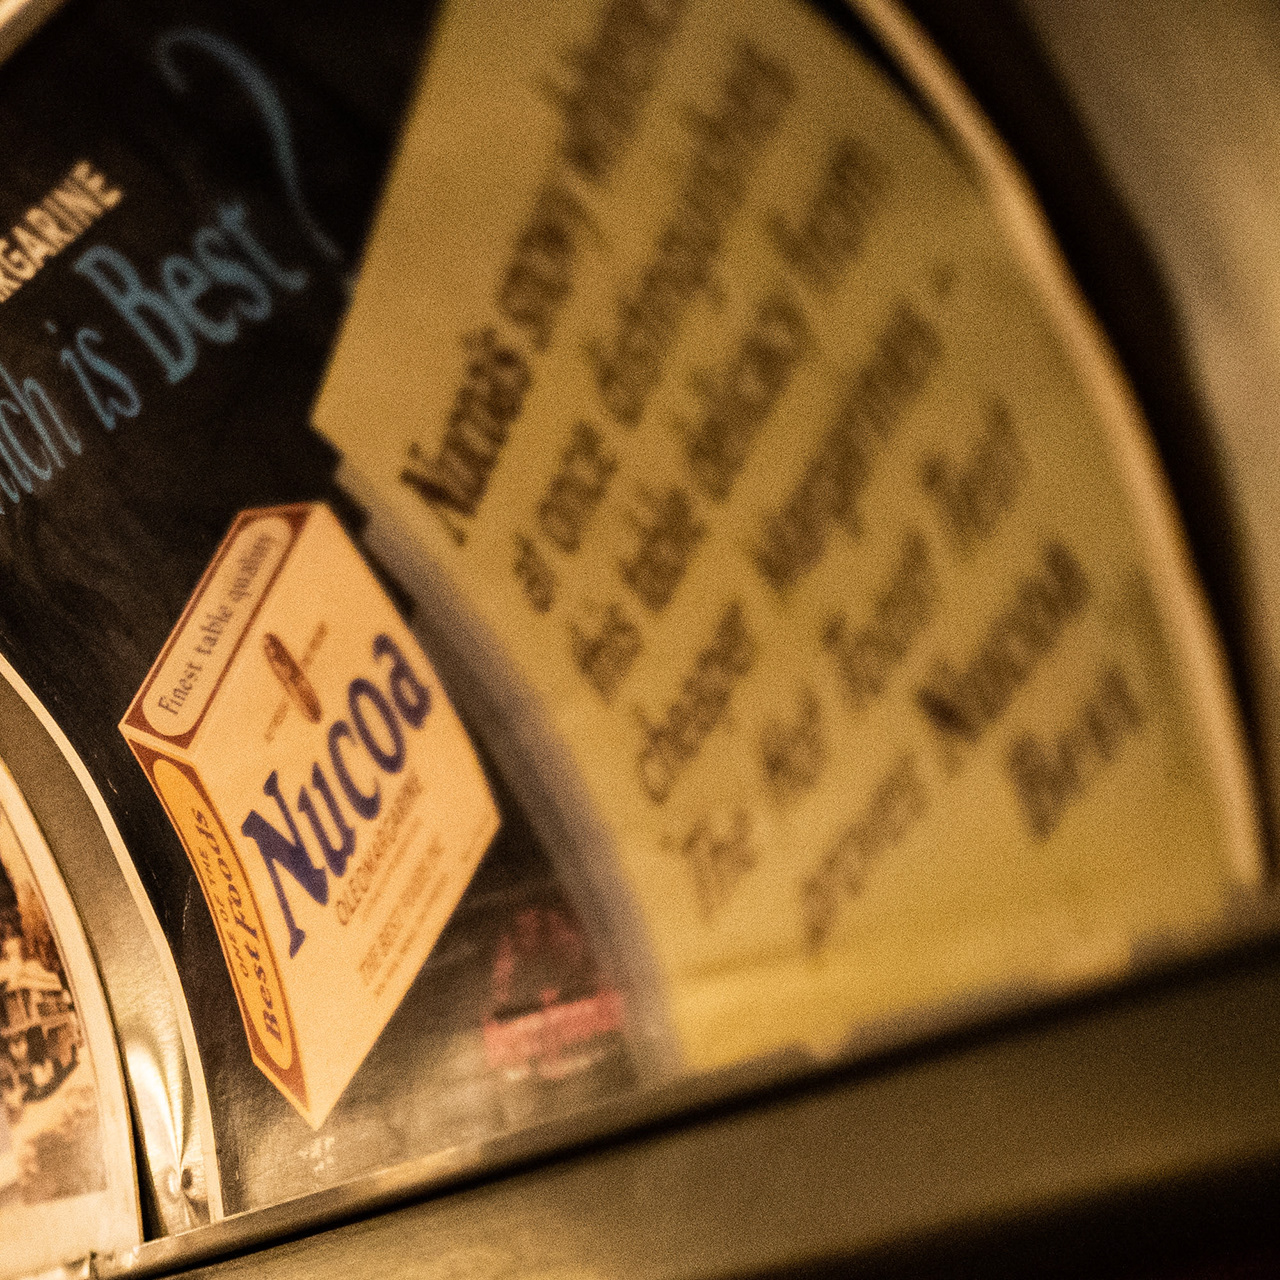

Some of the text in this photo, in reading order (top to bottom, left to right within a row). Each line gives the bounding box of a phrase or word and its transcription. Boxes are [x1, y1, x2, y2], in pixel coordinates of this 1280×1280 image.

[44, 319, 142, 431] is
[158, 662, 203, 716] Finest
[196, 604, 233, 656] table
[241, 633, 432, 960] Nucoa
[190, 806, 284, 1049] Best Foods
[197, 845, 249, 979] ONE OF THE
